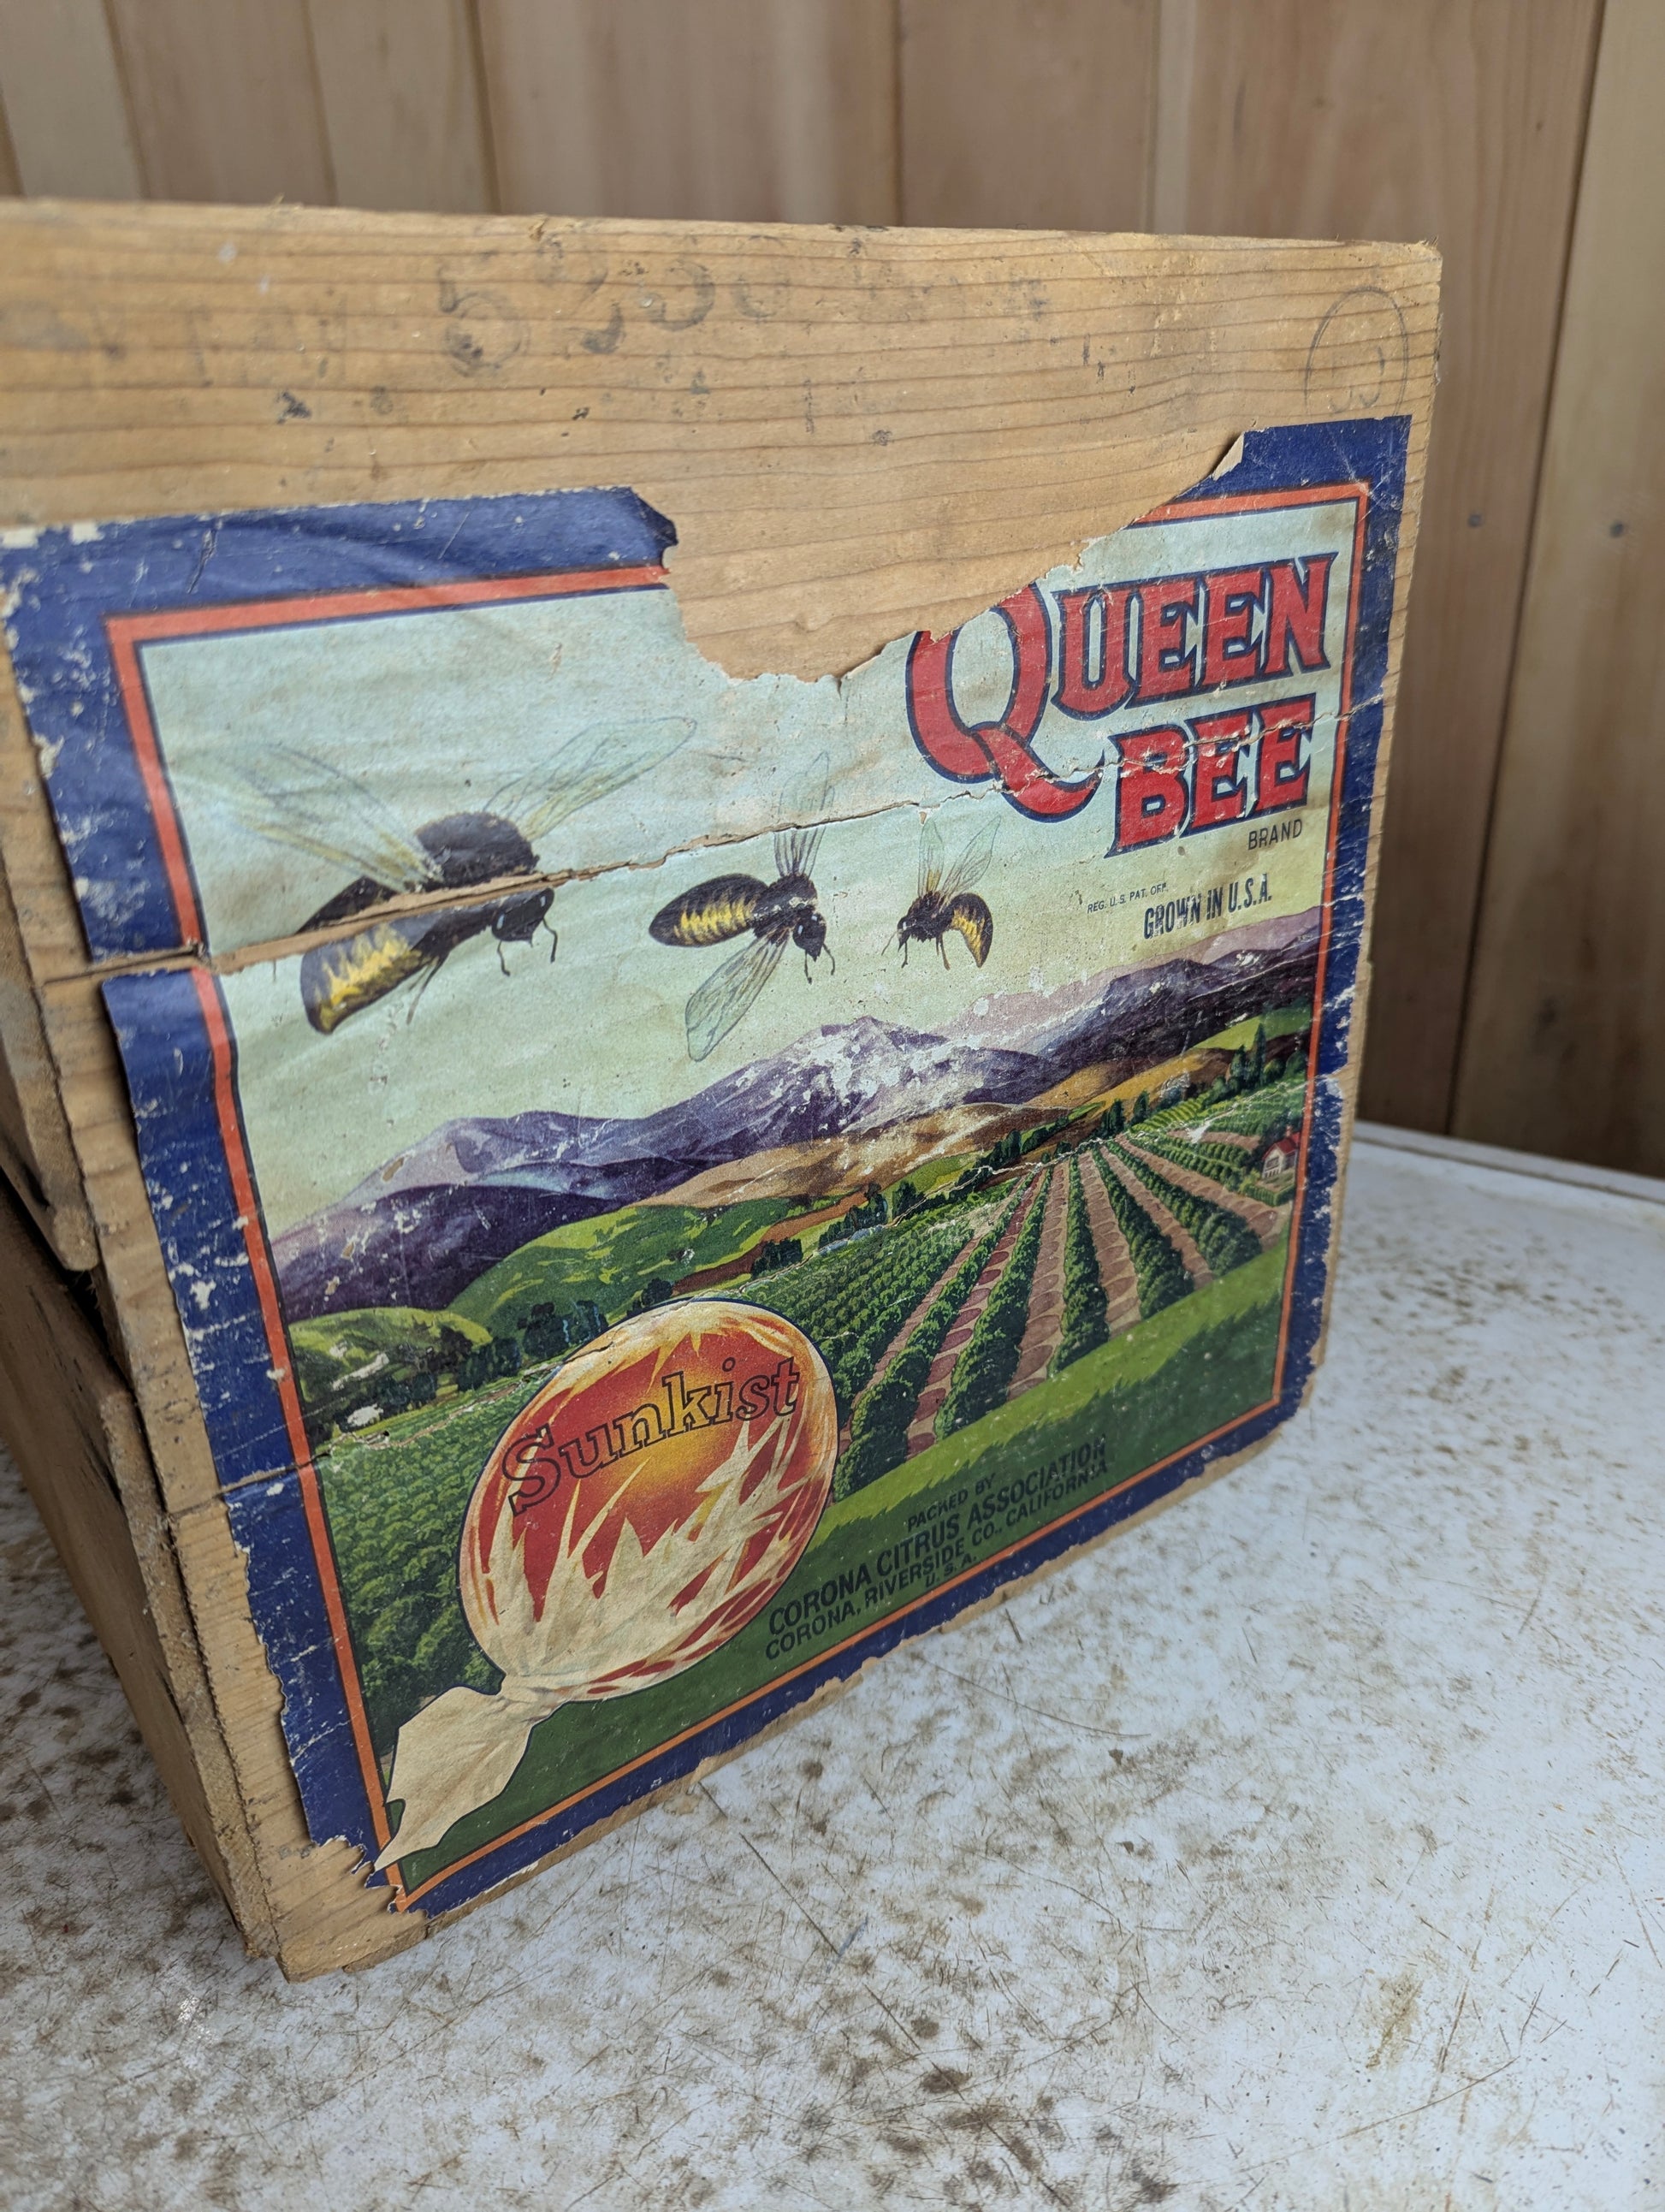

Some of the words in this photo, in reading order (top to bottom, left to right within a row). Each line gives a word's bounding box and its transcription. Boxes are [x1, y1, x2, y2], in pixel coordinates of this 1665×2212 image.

[905, 551, 1339, 823] QUEEN
[1103, 692, 1317, 858] BEE
[1247, 818, 1303, 851] BRAND
[1087, 900, 1107, 914] REG.
[1129, 888, 1148, 901] PAT.
[1143, 893, 1201, 940] GROWN
[1206, 886, 1224, 921] IN
[1227, 872, 1273, 914] U.S.A.
[501, 1356, 801, 1516] Sunkist
[907, 1488, 969, 1533] PACKED
[975, 1472, 996, 1496] BY
[765, 1601, 862, 1660] CORONA,
[864, 1537, 965, 1608] RIVERSIDE
[1005, 1458, 1108, 1527] CALIFORNIA
[768, 1562, 873, 1636] CORONA
[876, 1513, 960, 1576] CITRUS
[966, 1432, 1107, 1531] ASSOCIATION
